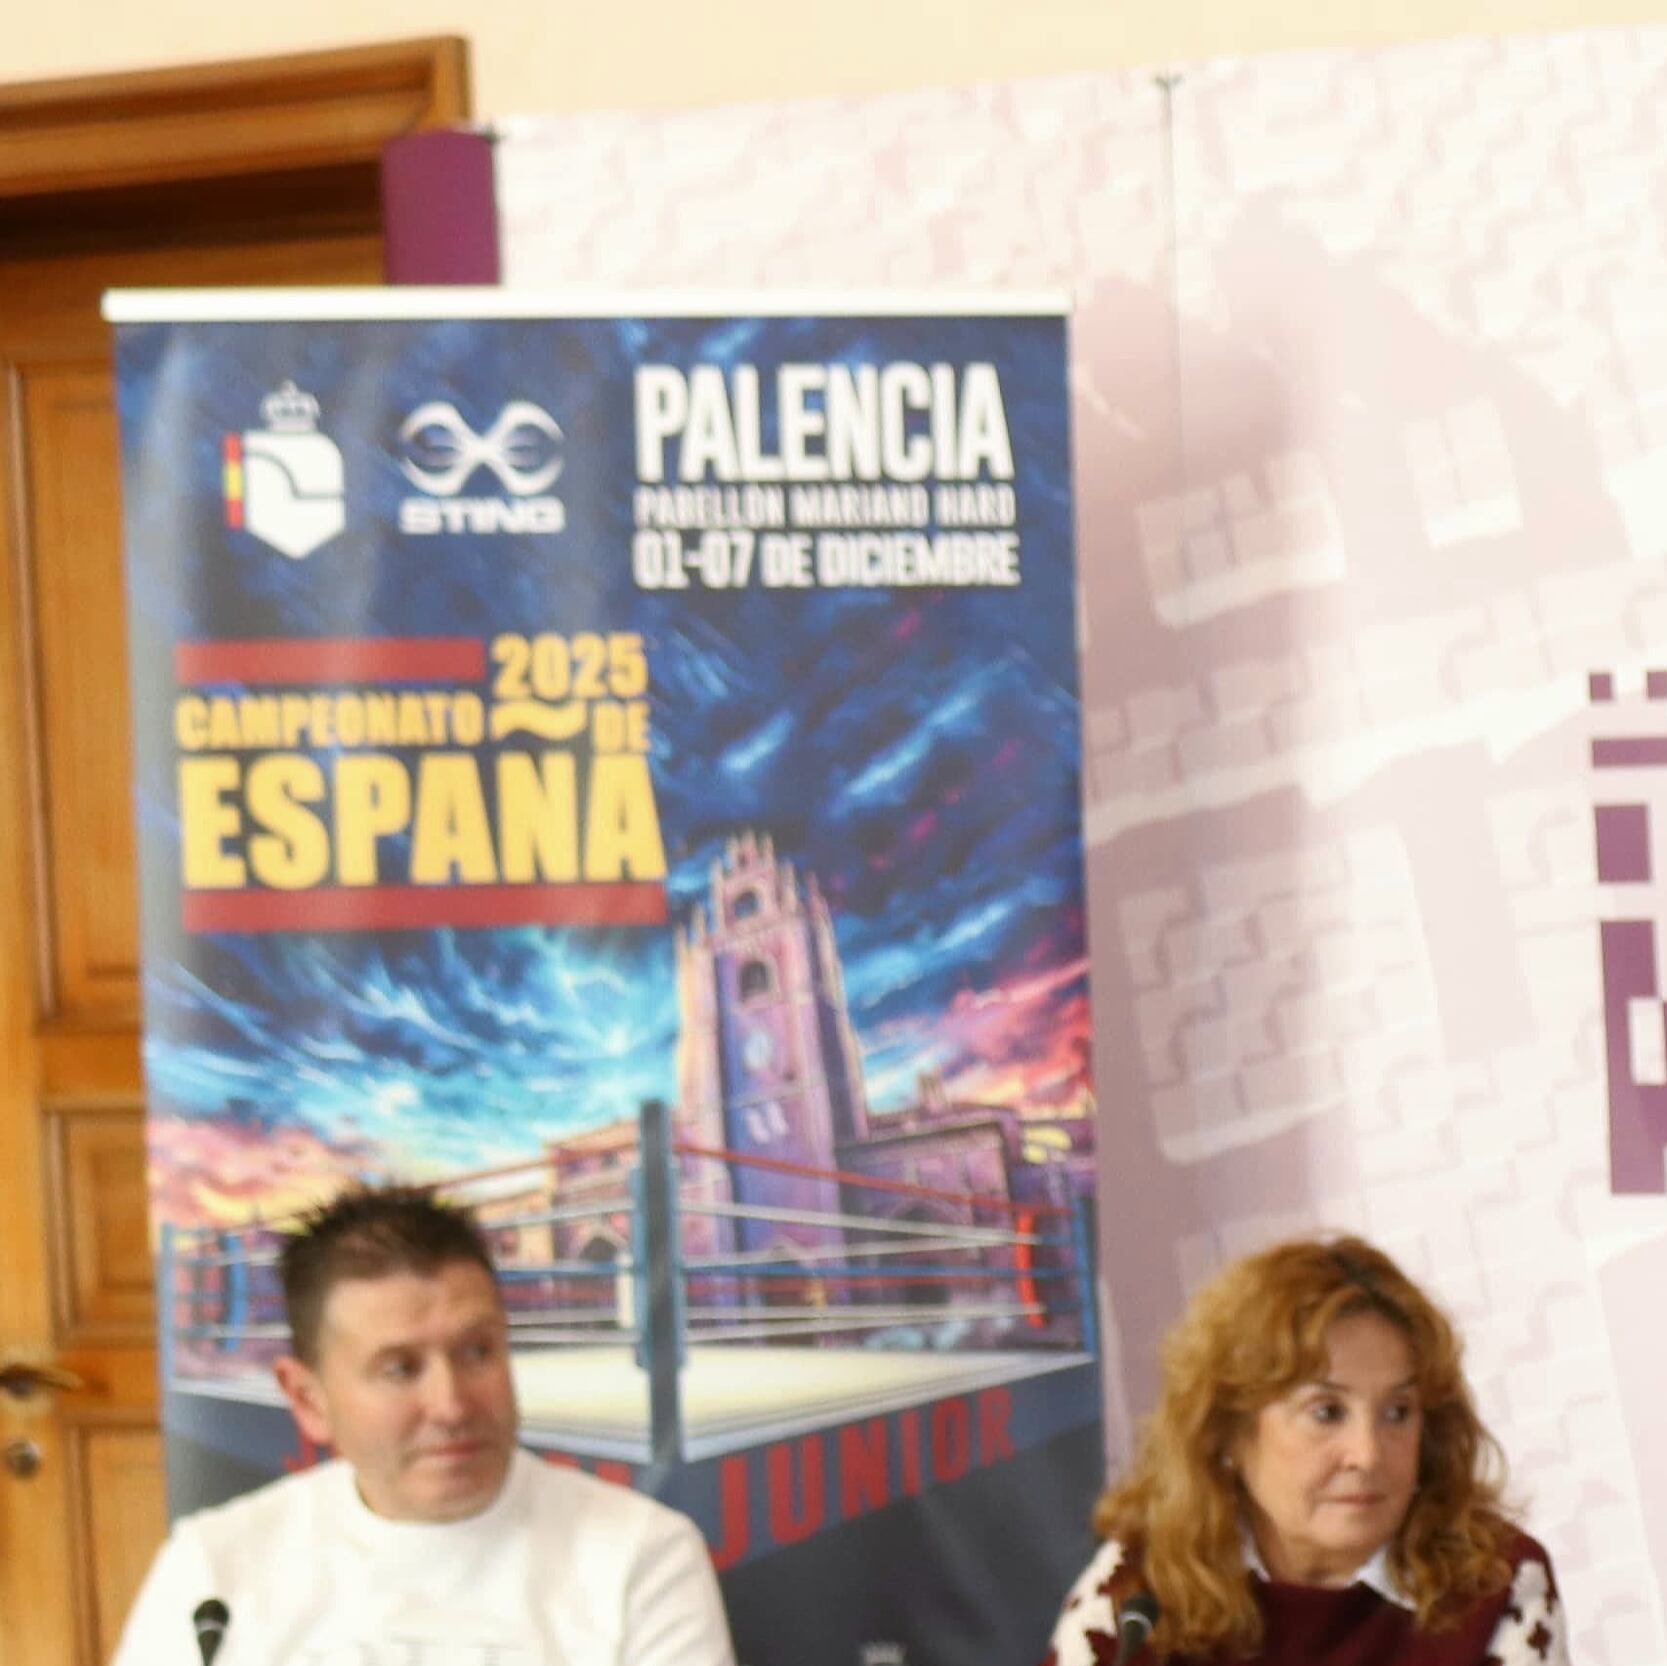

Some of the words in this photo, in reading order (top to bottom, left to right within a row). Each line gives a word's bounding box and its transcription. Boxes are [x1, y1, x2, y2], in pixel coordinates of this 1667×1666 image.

[634, 361, 1016, 482] PALENCIA
[401, 498, 565, 533] STING
[790, 483, 929, 529] MARIANO
[934, 482, 1016, 528] HARO
[632, 529, 755, 589] 01-07
[760, 531, 815, 588] DE
[817, 531, 1021, 588] DICIEMBRE
[491, 631, 649, 700] 2025
[175, 691, 486, 750] CAMPEONATO
[592, 702, 652, 753] DE
[178, 701, 668, 890] ESPAÑA
[708, 1385, 1016, 1574] JUNIOR
